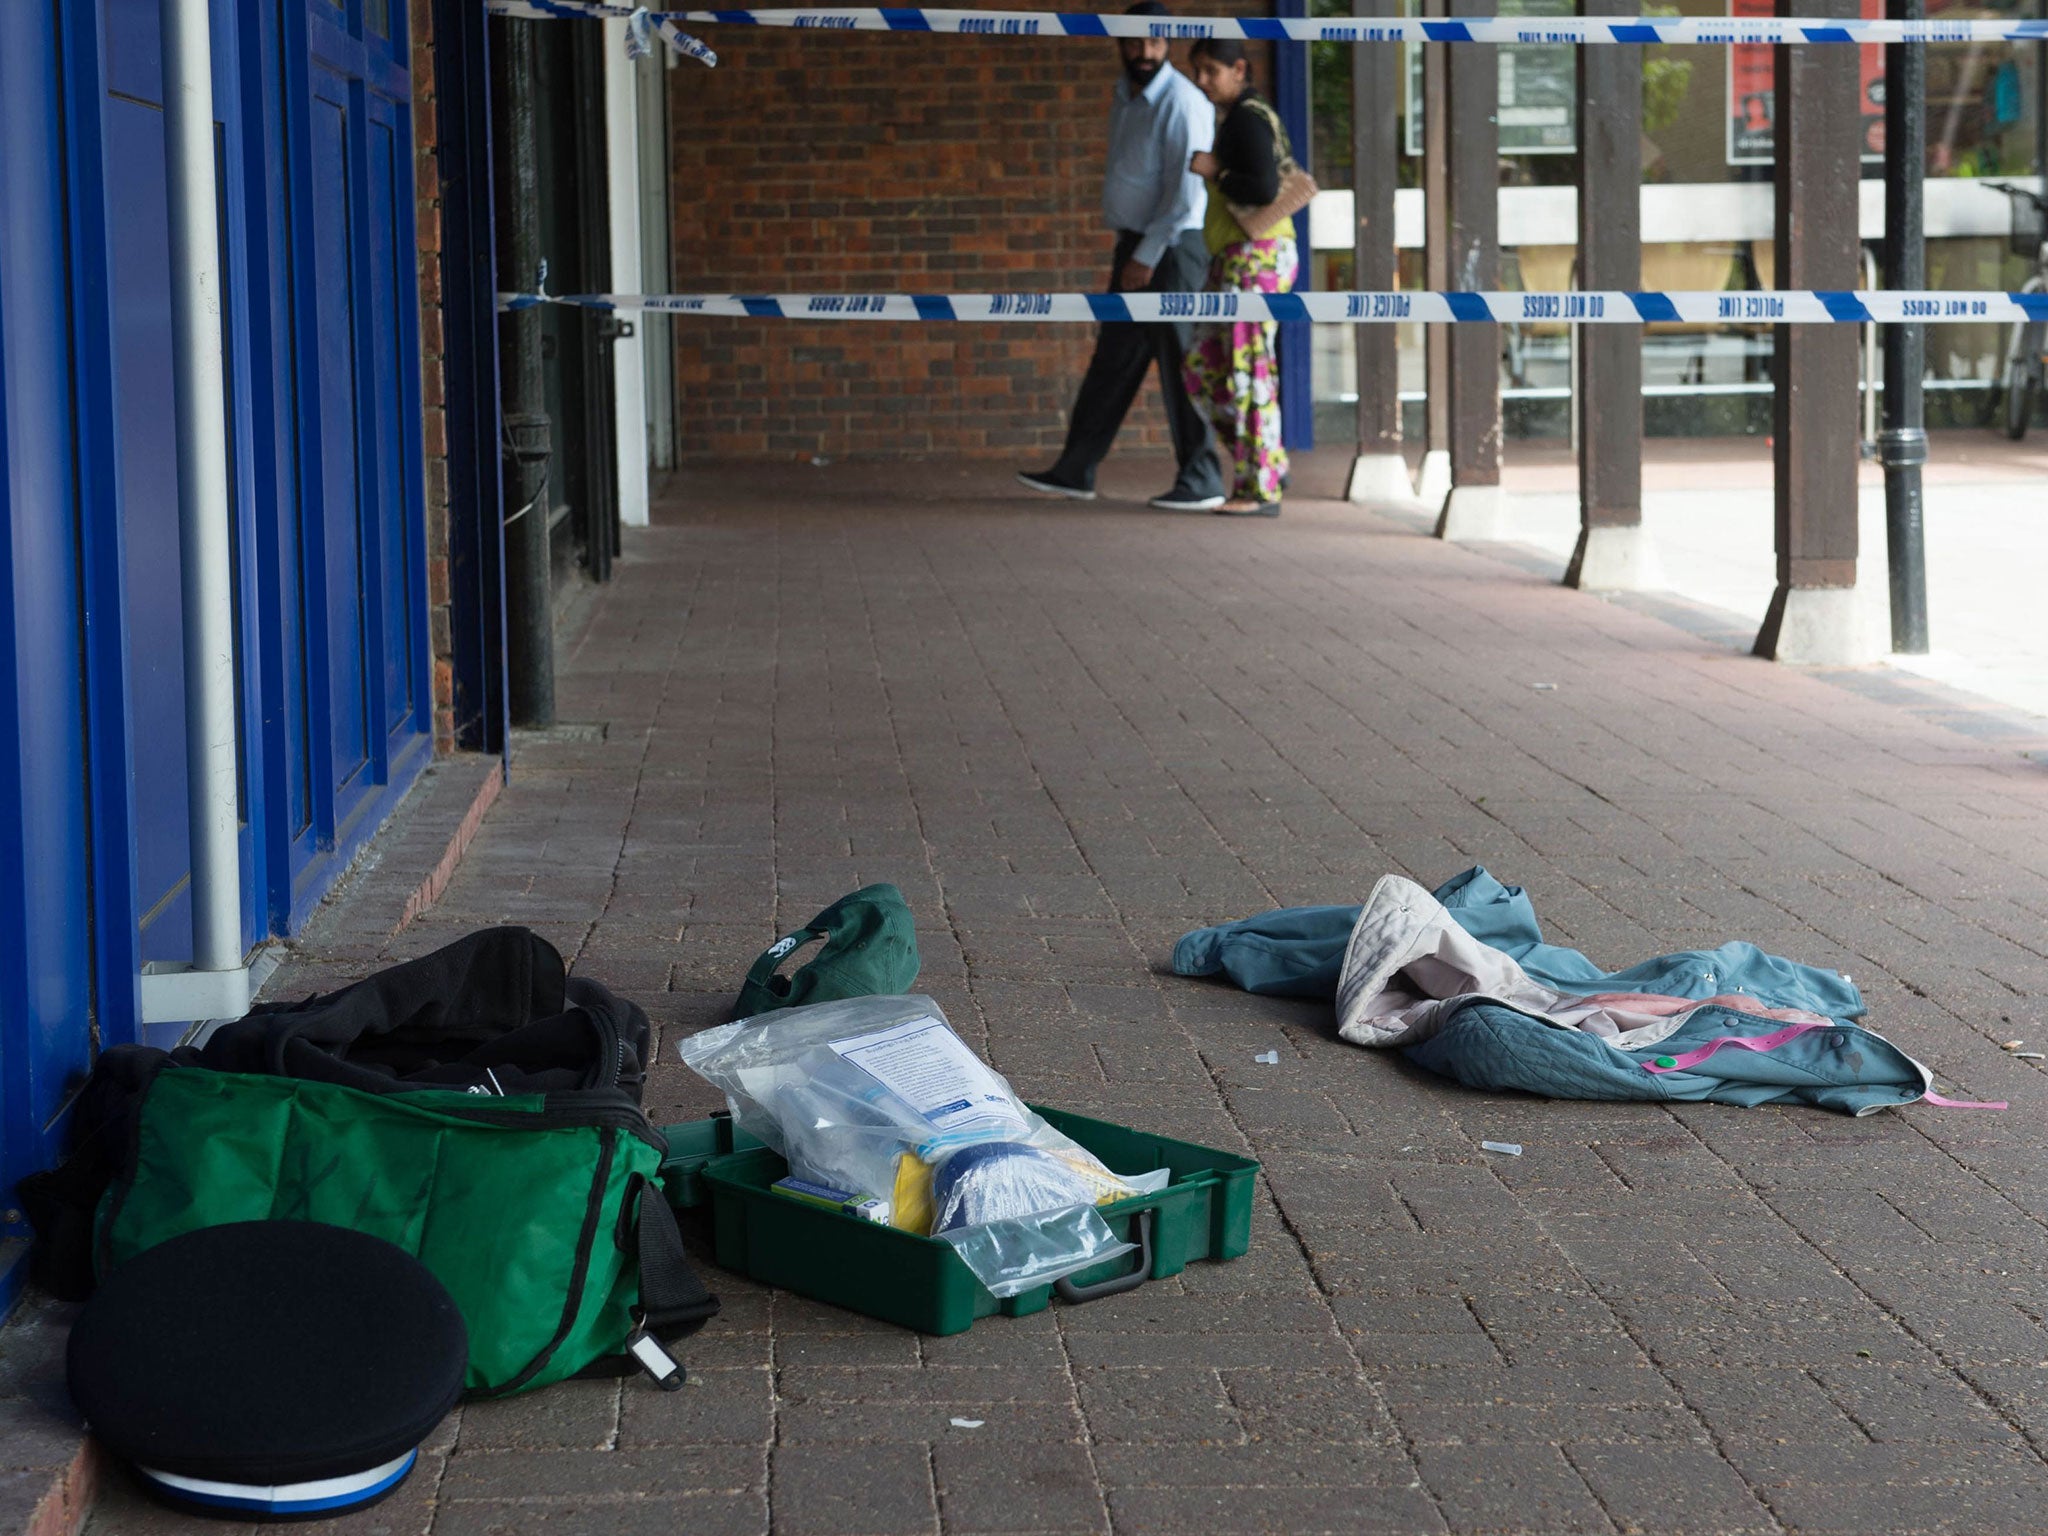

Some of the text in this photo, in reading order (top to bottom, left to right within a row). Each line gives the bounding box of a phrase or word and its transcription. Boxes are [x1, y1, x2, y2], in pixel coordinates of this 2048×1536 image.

[808, 296, 886, 313] DO NOT CROSS
[988, 294, 1052, 315] POLICE LINE
[1158, 294, 1238, 316] DO NOT CROSS
[1346, 295, 1410, 318] POLICE LINE
[1523, 296, 1604, 318] DO NOT CROSS
[1718, 296, 1784, 318] POLICE LINE
[1902, 299, 1987, 316] DO NOT CROSS
